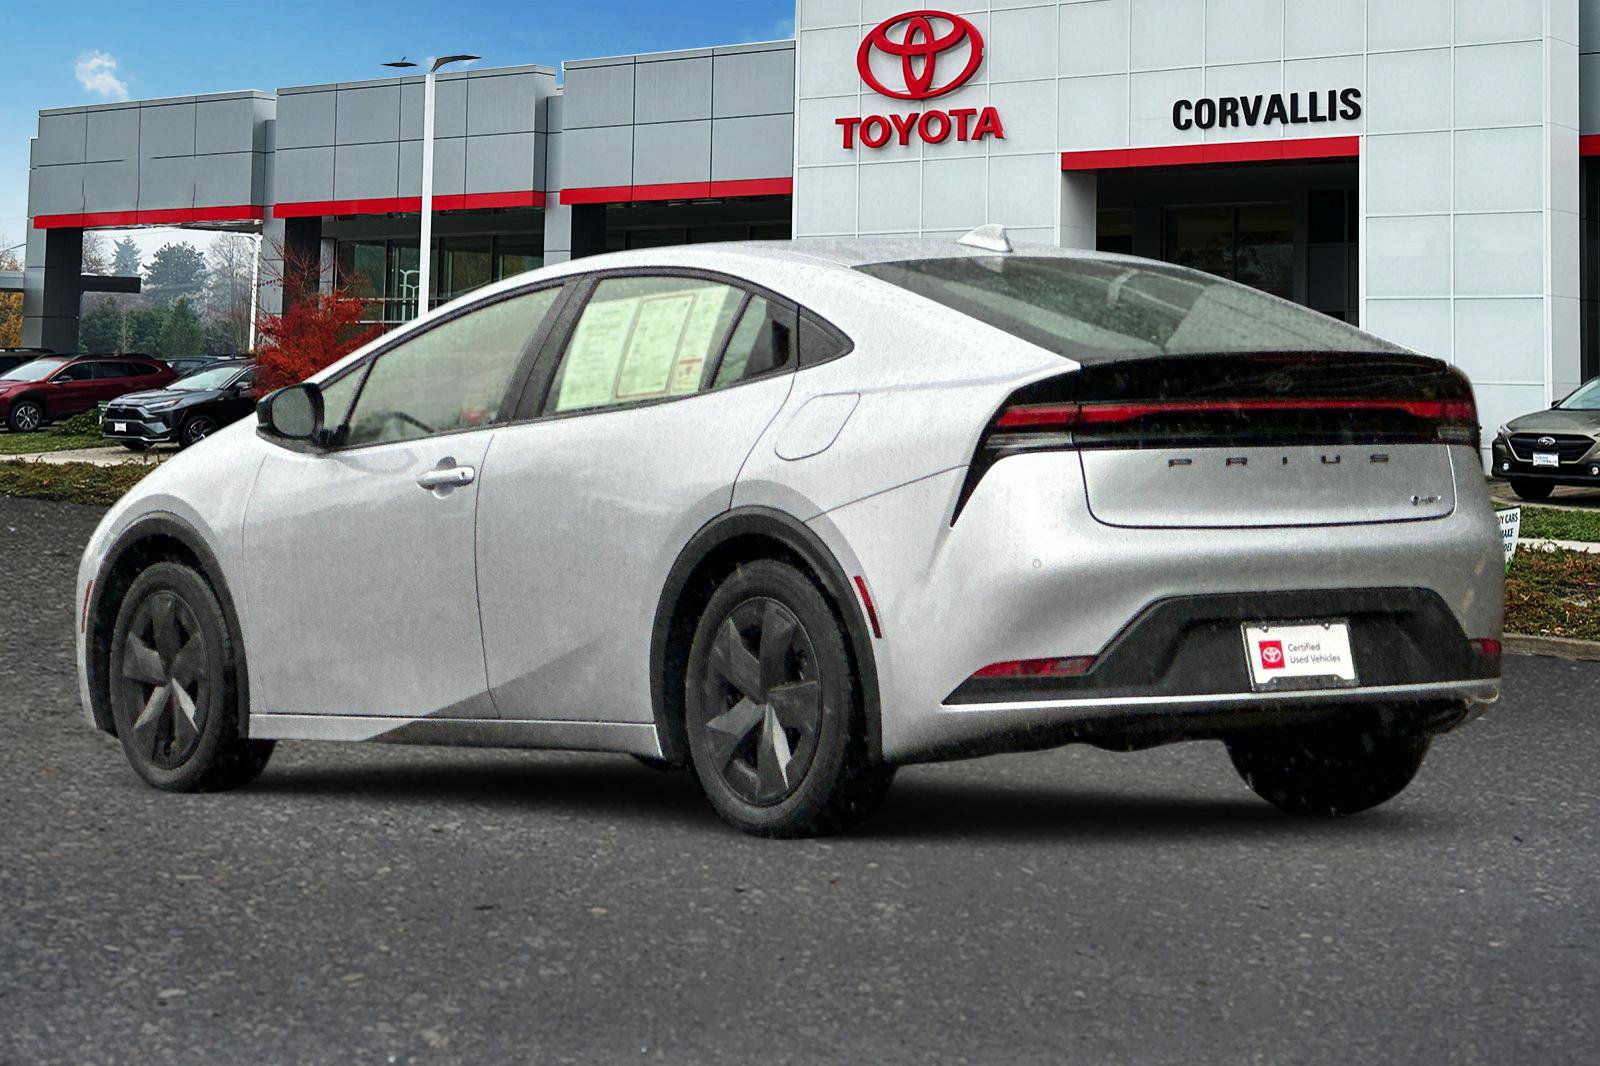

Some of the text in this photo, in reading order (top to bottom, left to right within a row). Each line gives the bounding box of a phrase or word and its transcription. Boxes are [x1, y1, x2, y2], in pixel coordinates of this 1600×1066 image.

[1172, 87, 1361, 131] CORVALLIS
[835, 107, 1006, 149] TOYOTA
[1168, 453, 1389, 467] PRIUS
[1505, 512, 1518, 524] CARS
[1504, 543, 1512, 552] DEL
[1288, 642, 1320, 652] Certified
[1290, 654, 1341, 664] Used Vehicles
